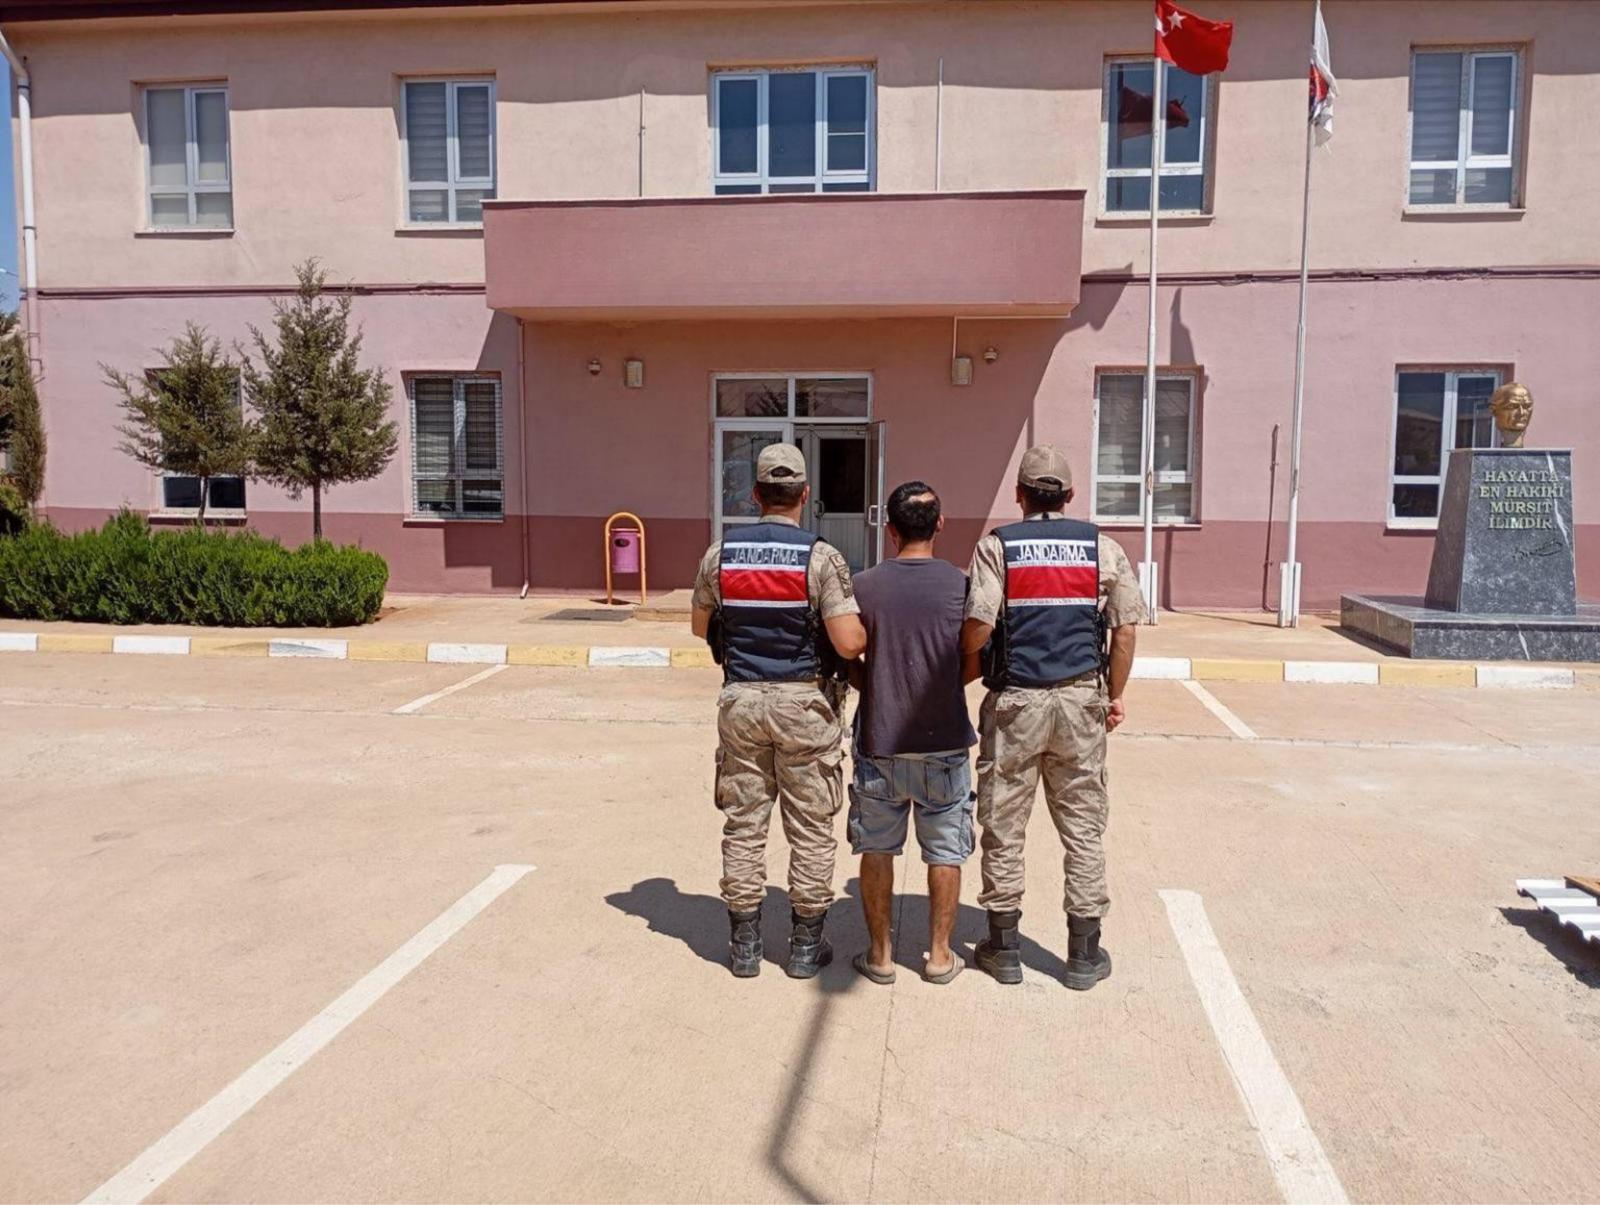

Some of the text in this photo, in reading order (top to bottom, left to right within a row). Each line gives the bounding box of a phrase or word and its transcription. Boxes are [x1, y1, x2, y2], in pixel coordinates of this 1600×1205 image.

[1484, 470, 1559, 482] HAYATTA
[1479, 485, 1500, 498] EN
[731, 547, 799, 565] JANDARMA
[1016, 544, 1088, 561] JANDARMA
